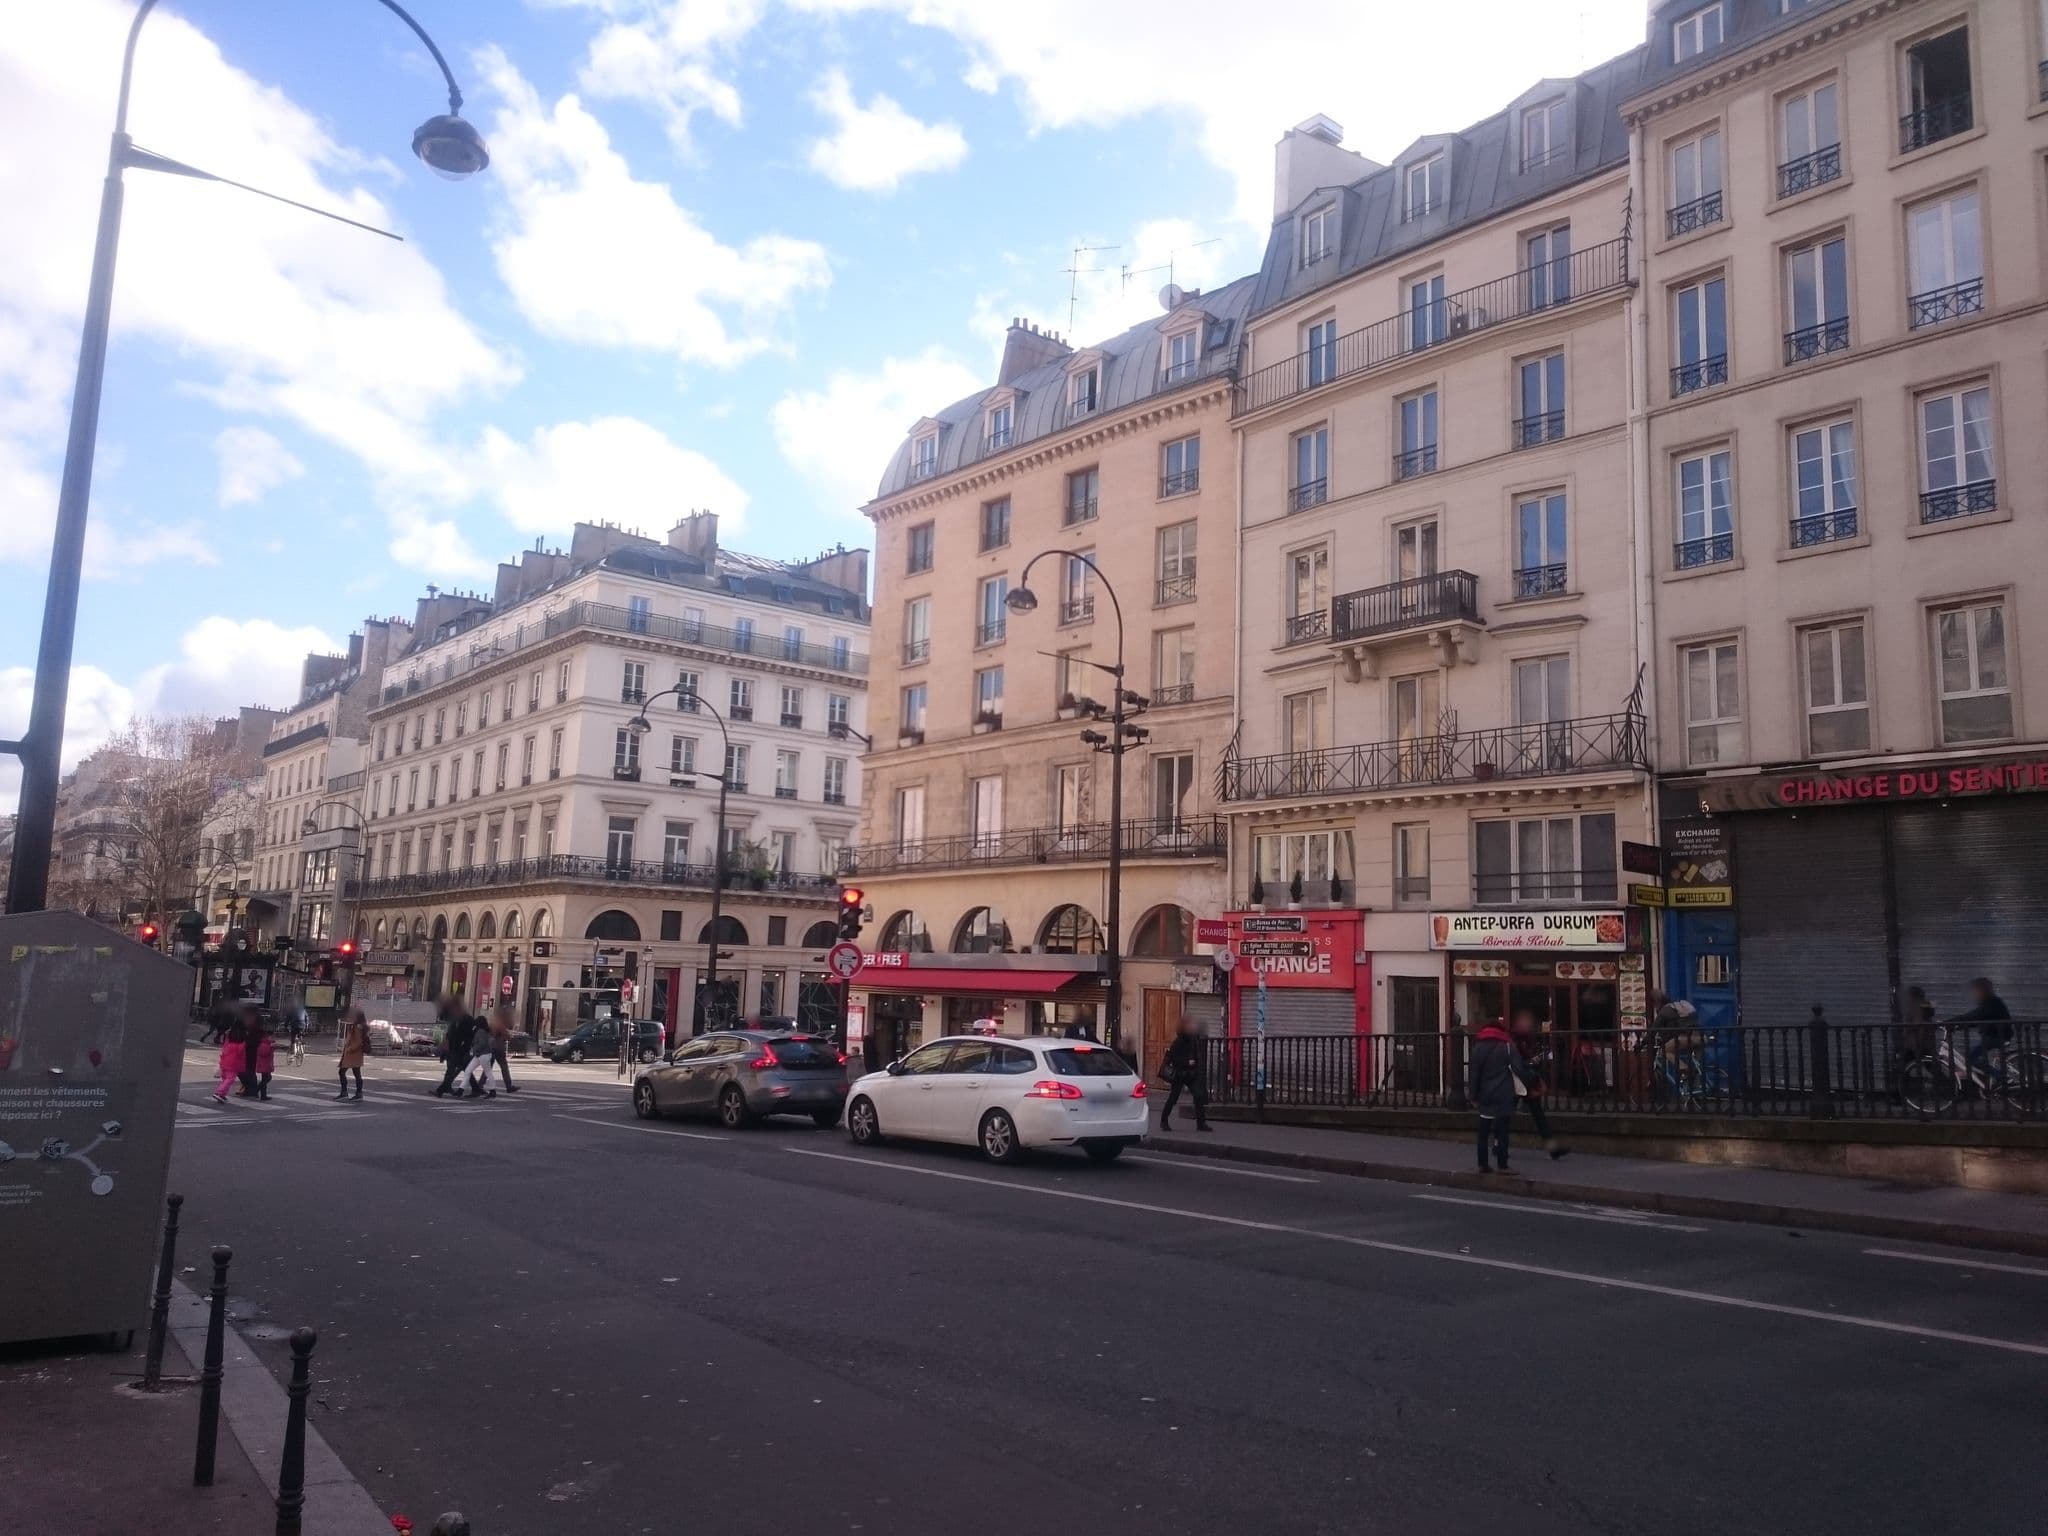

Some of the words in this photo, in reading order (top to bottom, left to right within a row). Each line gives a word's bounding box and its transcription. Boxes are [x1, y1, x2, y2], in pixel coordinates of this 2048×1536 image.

[1779, 775, 1889, 803] CHANGE
[1898, 773, 1938, 796] DU
[1948, 763, 2048, 793] SENTIE
[1675, 828, 1721, 838] EXCHANGE
[1454, 915, 1534, 930] ANTEP-URFA
[1543, 915, 1595, 930] DURUM
[1199, 927, 1228, 937] CHANGE
[1481, 935, 1526, 947] Birecik
[1526, 935, 1565, 946] Kebab
[882, 954, 902, 966] FRIES
[1250, 953, 1331, 975] CHANGE
[46, 1098, 105, 1108] chaussures
[0, 1110, 41, 1121] éposez
